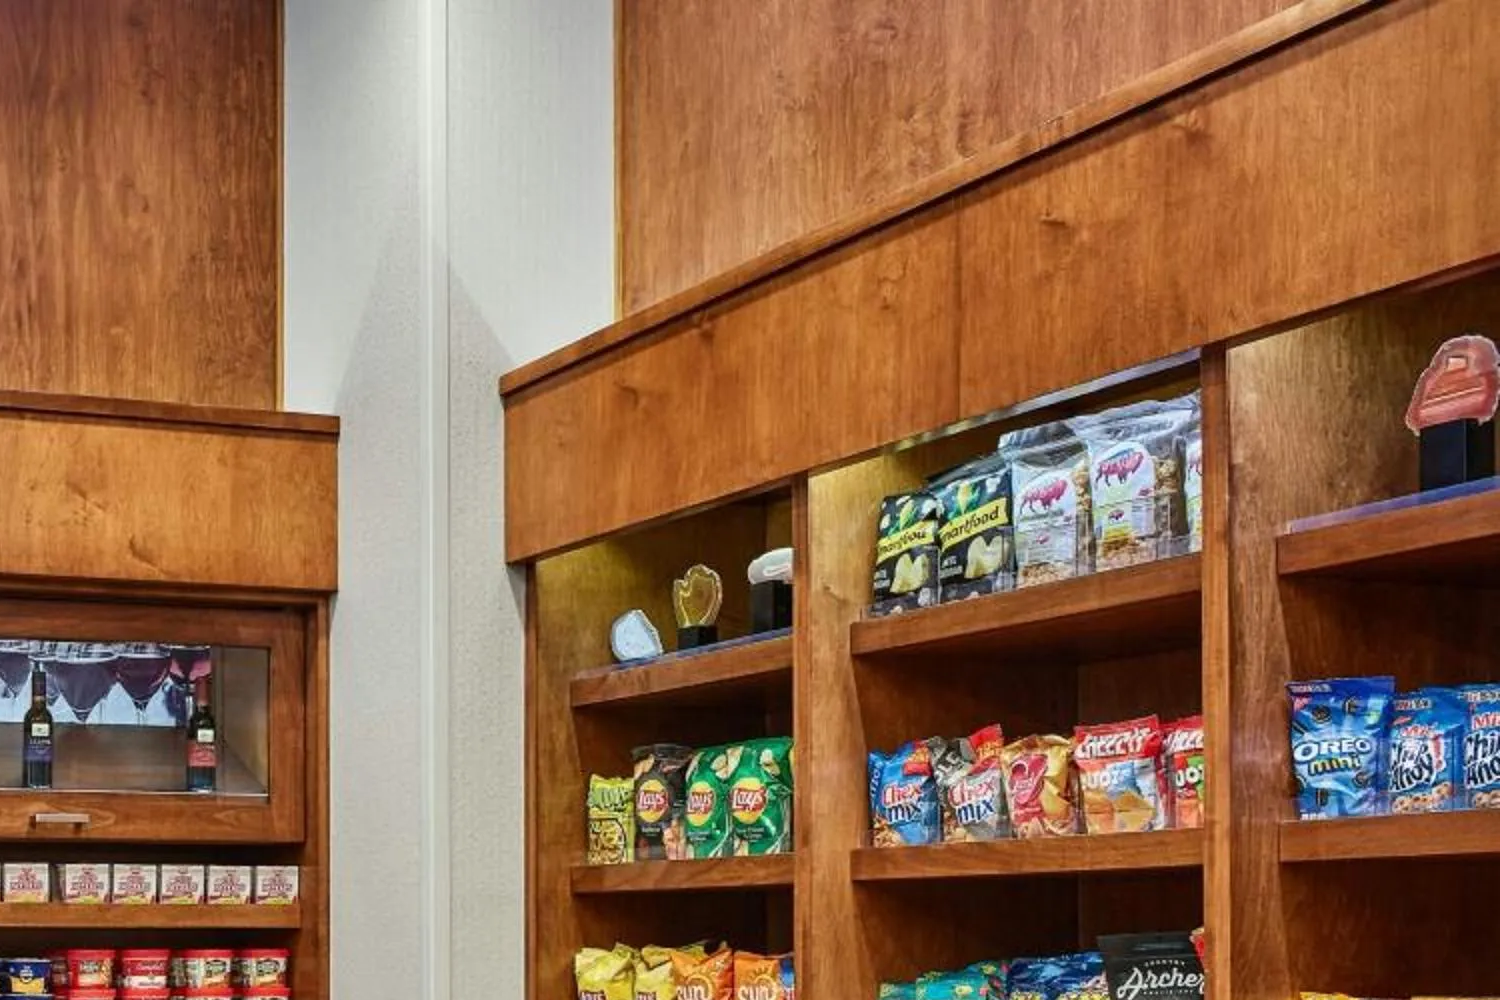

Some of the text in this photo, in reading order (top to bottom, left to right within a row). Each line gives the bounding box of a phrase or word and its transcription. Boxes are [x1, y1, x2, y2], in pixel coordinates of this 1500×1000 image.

[1293, 737, 1371, 763] OREO
[1308, 756, 1361, 776] mini
[956, 799, 994, 825] mix
